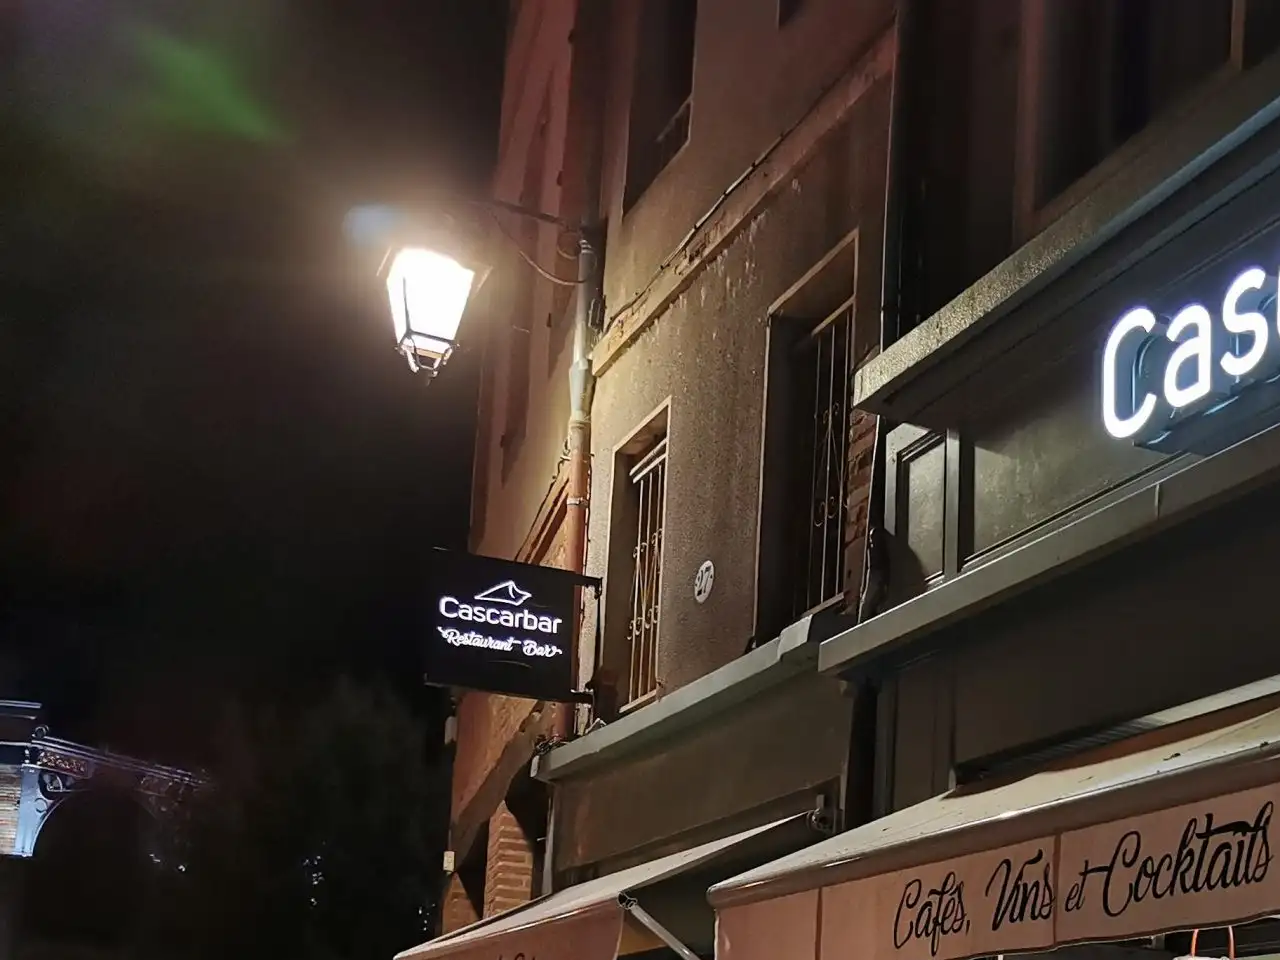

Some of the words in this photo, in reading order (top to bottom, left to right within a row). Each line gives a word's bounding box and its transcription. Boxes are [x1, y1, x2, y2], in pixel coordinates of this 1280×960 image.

[439, 596, 562, 634] Cascarbar
[436, 626, 521, 652] Restaurant
[521, 640, 563, 658] Bar
[893, 871, 970, 957] Cafés,
[985, 848, 1055, 931] Vins
[1064, 859, 1107, 913] et
[1102, 800, 1274, 917] Cocktails
